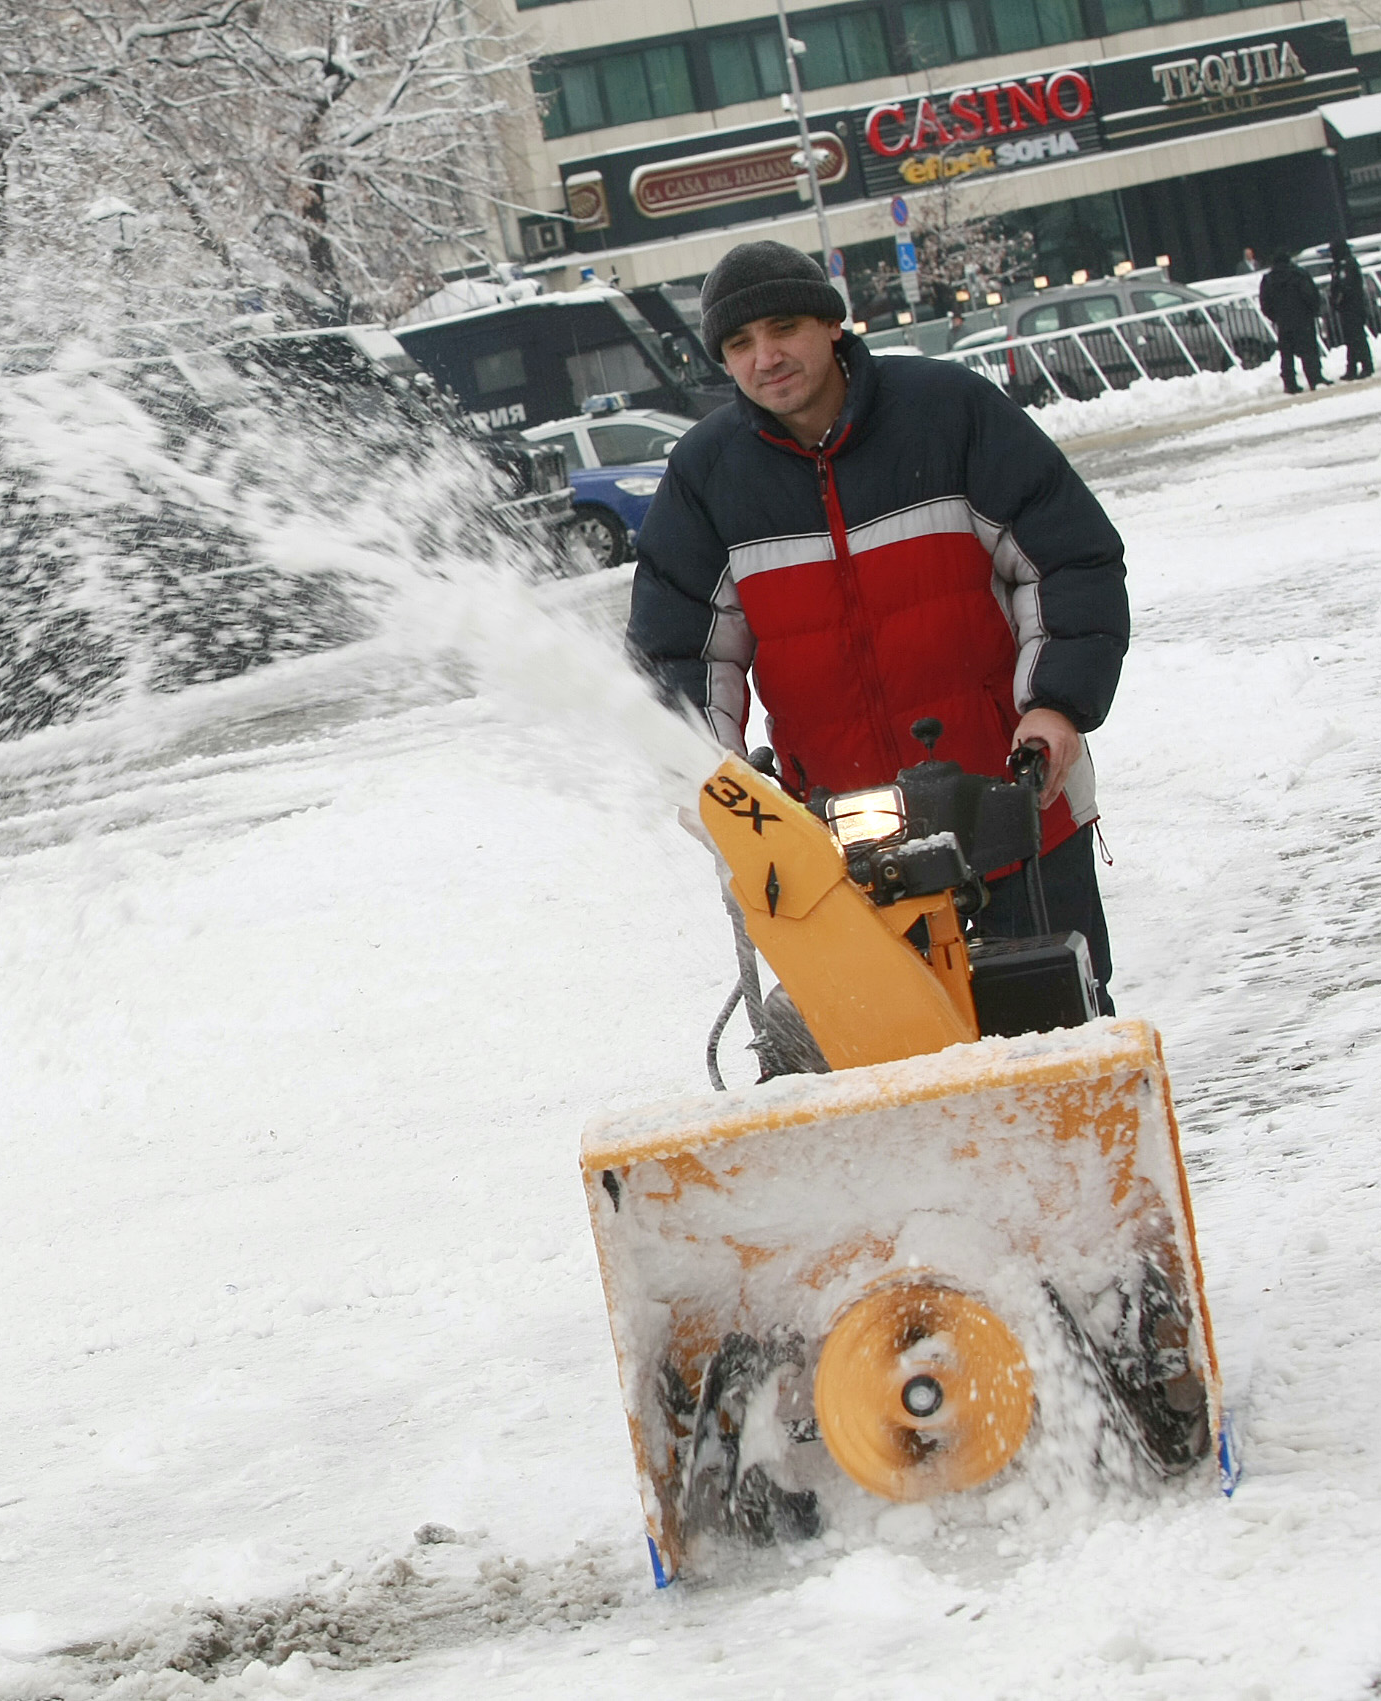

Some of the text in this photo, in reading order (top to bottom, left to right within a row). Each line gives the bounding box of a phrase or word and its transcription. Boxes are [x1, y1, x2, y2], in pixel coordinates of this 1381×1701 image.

[865, 70, 1093, 157] CASINO
[996, 131, 1080, 166] SOFIA
[644, 187, 662, 202] LA
[664, 179, 704, 200] CASA
[708, 175, 733, 190] DEL
[704, 776, 783, 836] 3X
